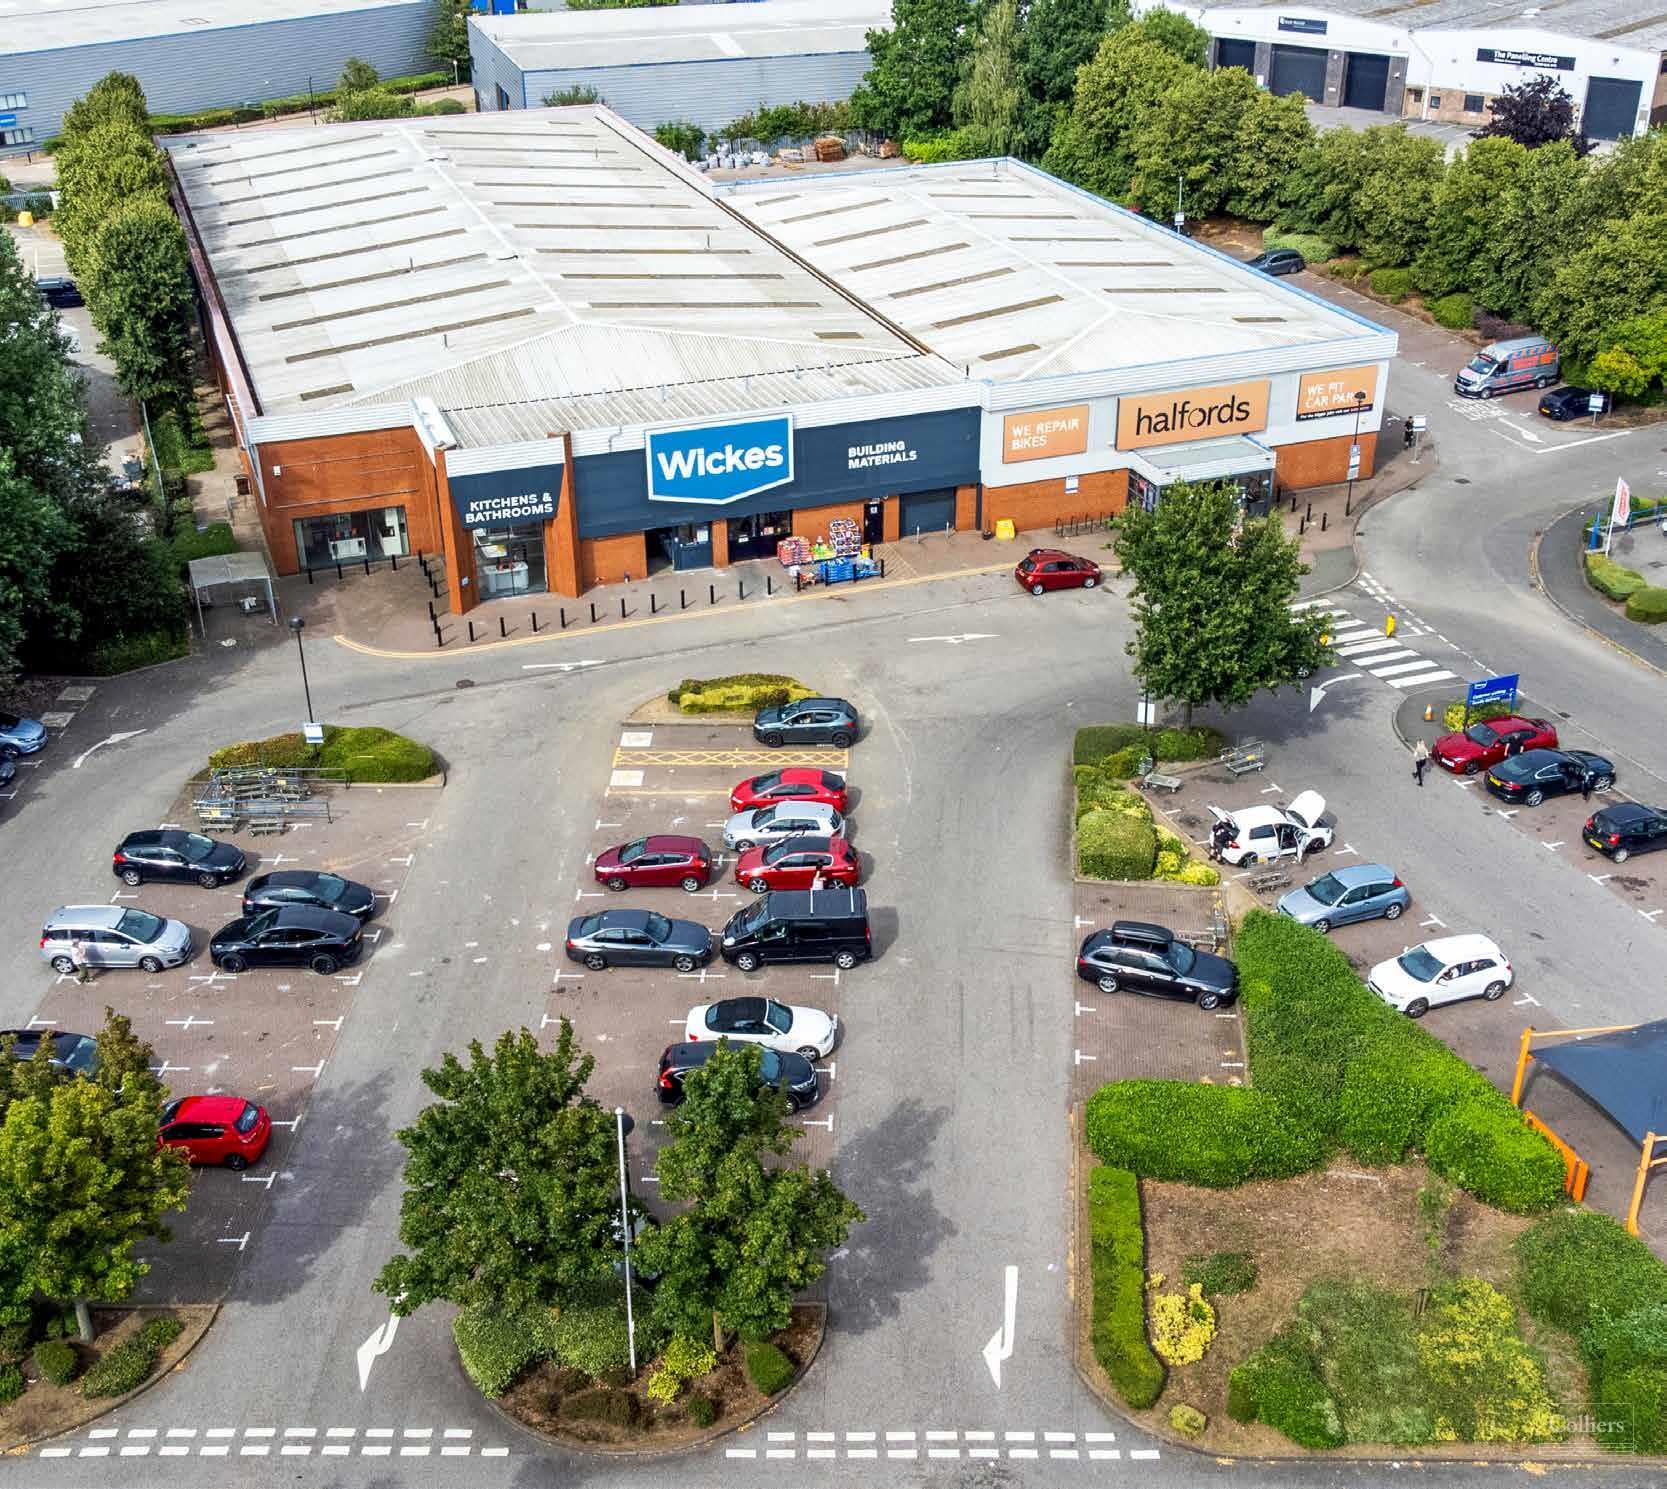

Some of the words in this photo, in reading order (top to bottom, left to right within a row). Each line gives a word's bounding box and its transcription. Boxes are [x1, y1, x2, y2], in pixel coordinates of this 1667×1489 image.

[1536, 55, 1558, 63] Centre
[1307, 383, 1326, 396] WE
[1304, 395, 1328, 408] CAR
[1135, 395, 1250, 436] halfords
[1012, 423, 1031, 438] WE
[1036, 418, 1080, 433] REPAIR
[848, 440, 905, 458] BUILDING
[1011, 434, 1048, 450] BIKES
[657, 444, 784, 481] Wickes
[848, 450, 917, 469] MATERIALS
[470, 493, 538, 512] KITCHENS
[542, 492, 553, 502] &
[465, 503, 553, 524] BATHROOMS
